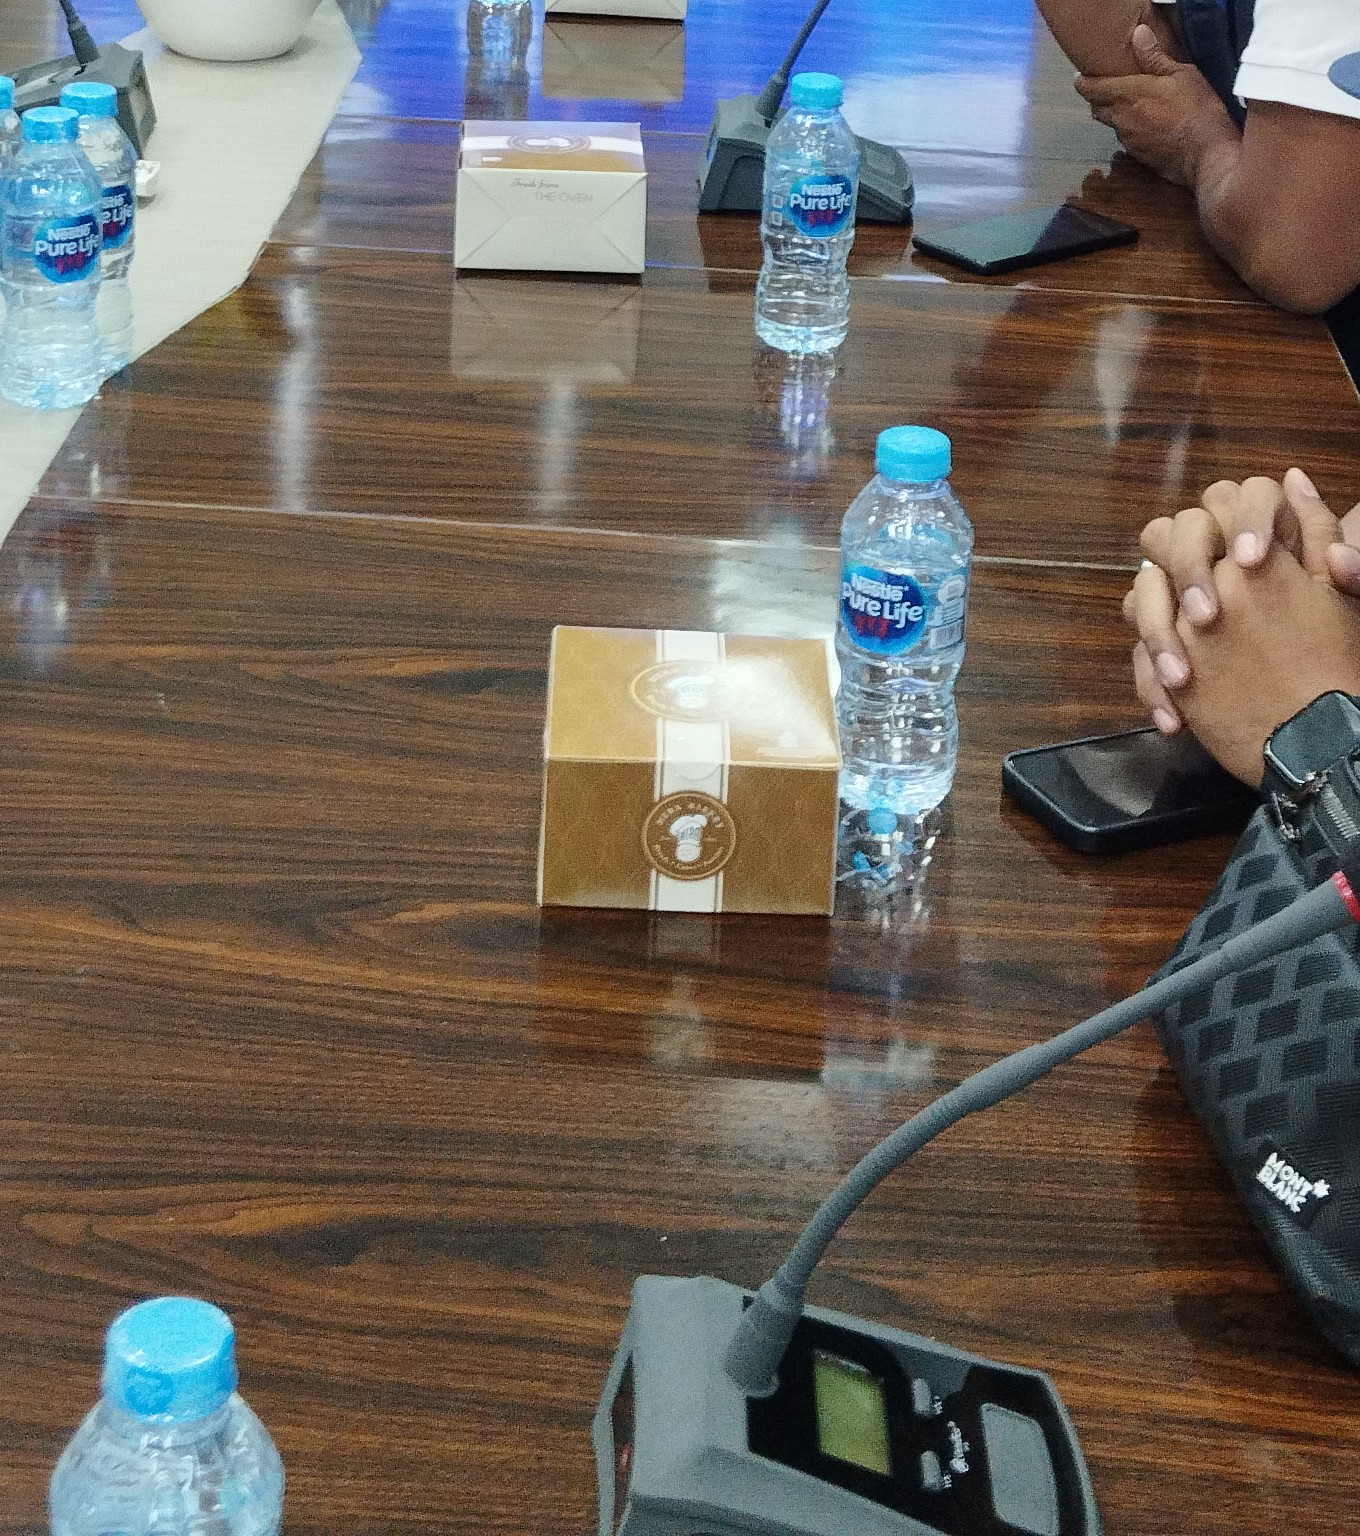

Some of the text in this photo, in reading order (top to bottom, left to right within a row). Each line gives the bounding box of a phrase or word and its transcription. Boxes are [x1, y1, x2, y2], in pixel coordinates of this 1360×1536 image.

[789, 192, 852, 214] Pure Life
[34, 240, 78, 258] Pure
[842, 581, 925, 629] Pure Life
[1255, 1164, 1307, 1214] BLANC
[1264, 1152, 1314, 1197] MONT
